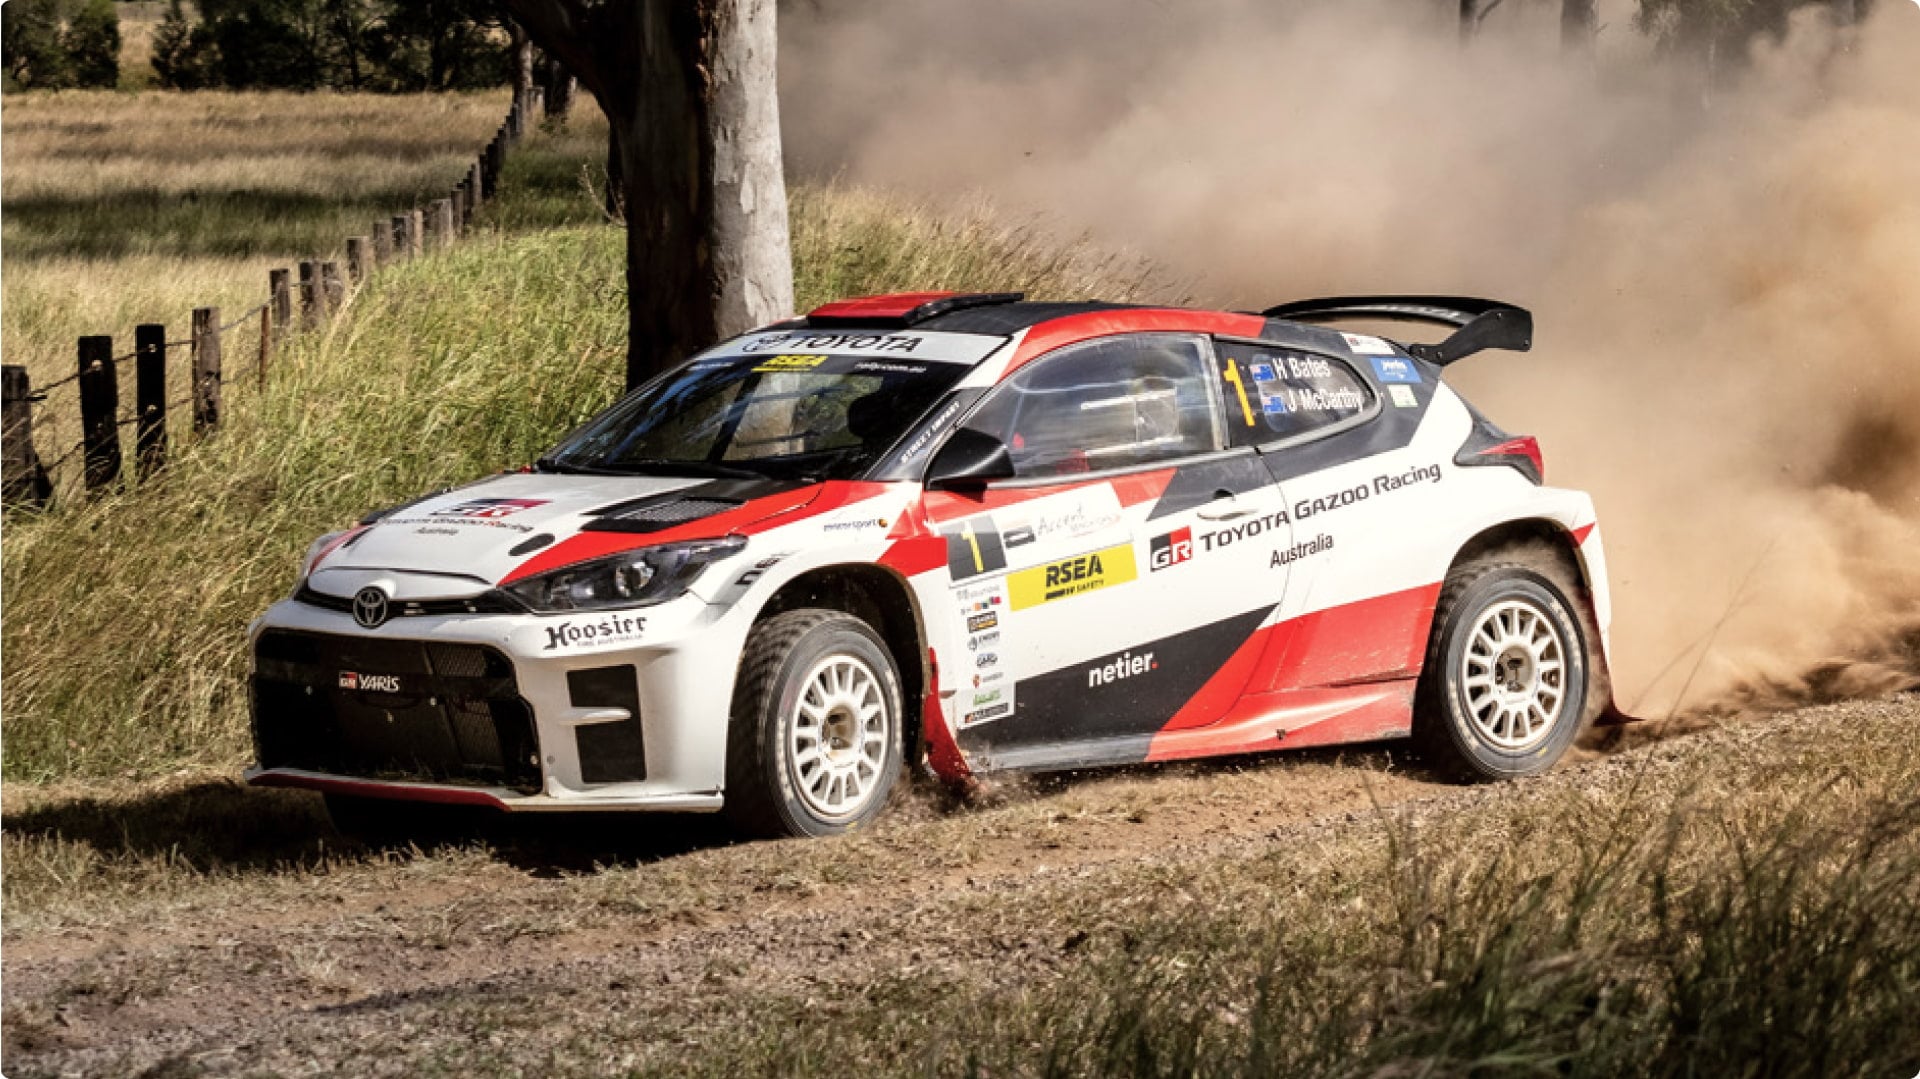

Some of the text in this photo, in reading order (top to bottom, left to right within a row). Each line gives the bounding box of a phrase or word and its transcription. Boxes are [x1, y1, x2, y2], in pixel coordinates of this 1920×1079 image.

[791, 334, 923, 353] TOYOTA
[1223, 357, 1332, 426] 1 H Bates
[1288, 386, 1363, 413] J McCarthy
[1152, 463, 1442, 571] GR TOYOTA GAZOO Racing
[960, 520, 984, 573] 1
[1270, 533, 1335, 569] Australia
[1045, 554, 1103, 588] RSEA
[1077, 579, 1104, 593] SAFETY
[543, 614, 648, 650] Hoosier
[359, 673, 401, 692] YARIS
